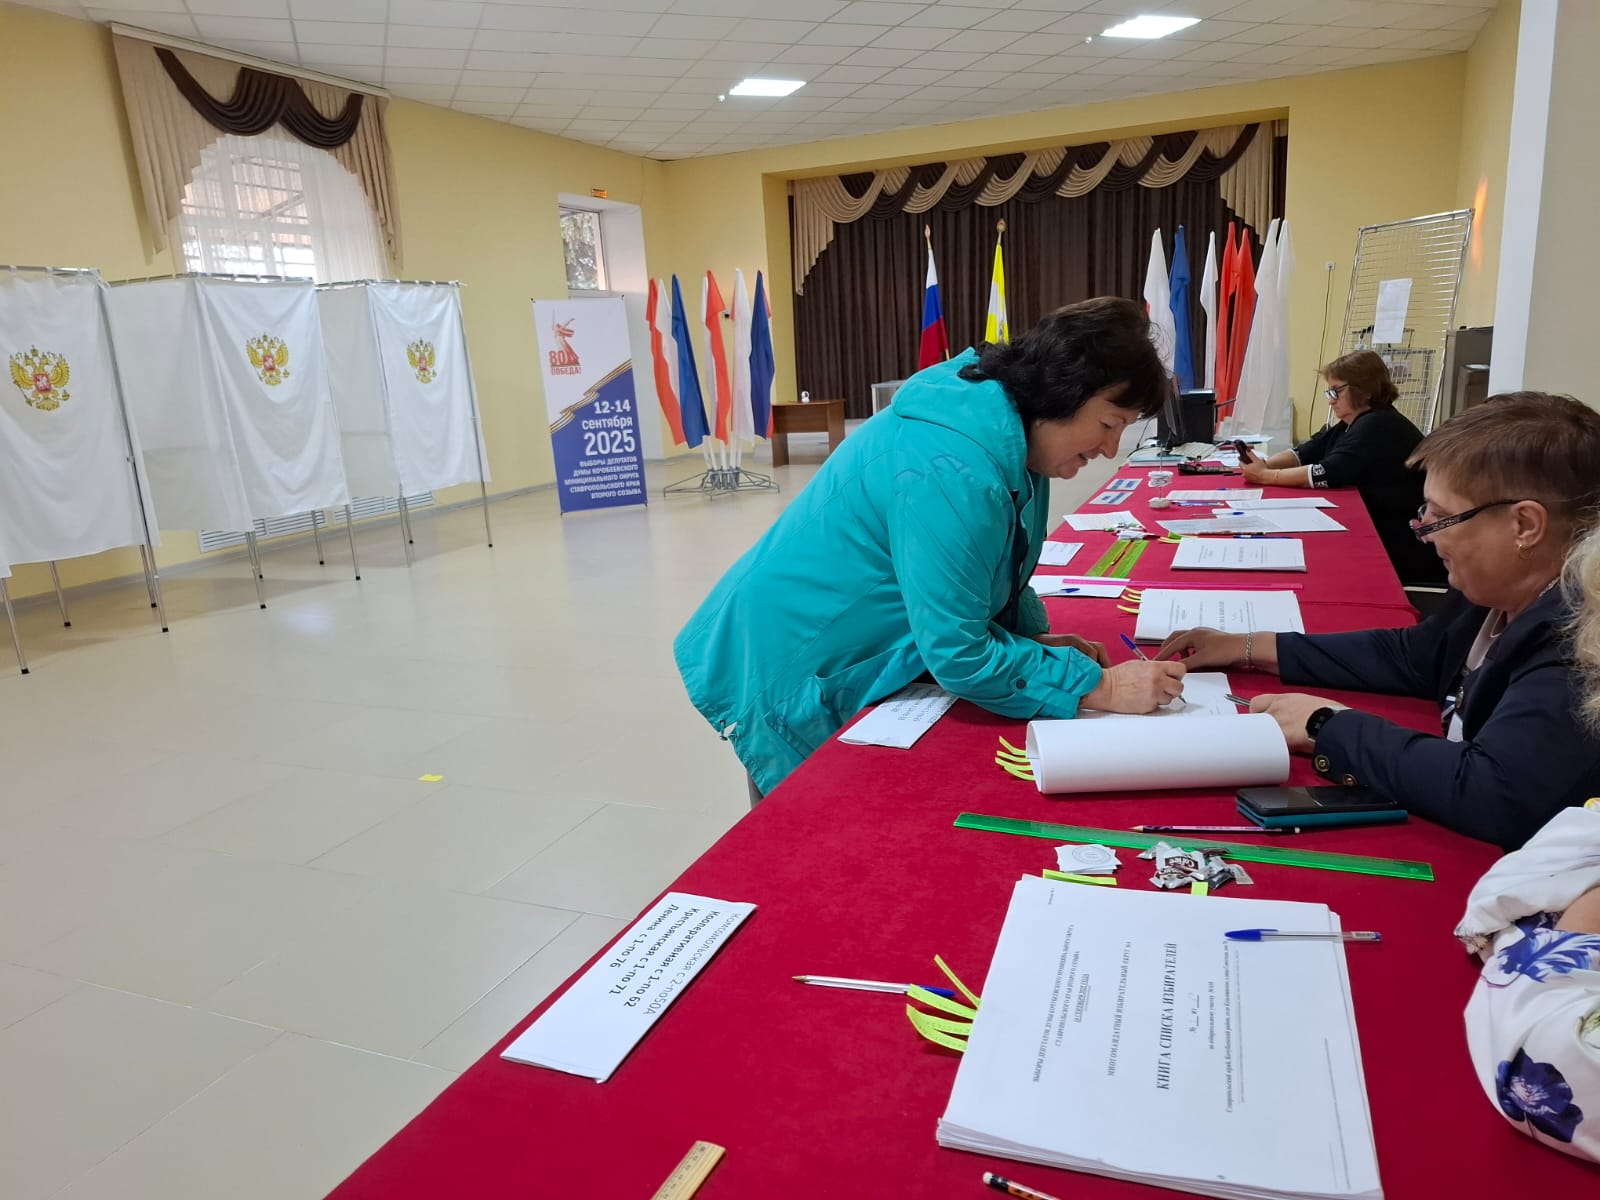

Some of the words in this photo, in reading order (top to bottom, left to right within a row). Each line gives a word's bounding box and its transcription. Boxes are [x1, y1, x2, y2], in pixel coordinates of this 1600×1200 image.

[551, 366, 581, 376] ПОБЕДА!
[594, 400, 631, 414] 12-14
[582, 416, 633, 430] сентября
[584, 429, 635, 456] 2025
[607, 456, 637, 464] ДЕПУТАТОВ
[564, 474, 618, 485] МУНИЦИПАЛЬНОГО
[573, 469, 591, 477] ДУМЫ
[570, 482, 624, 493] СТАВРОПОЛЬСКОГО
[592, 491, 616, 499] ВТОРОГО
[647, 904, 679, 930] Ленина
[646, 908, 700, 956] Крестьянская
[660, 911, 720, 968] Кооперативная
[621, 939, 644, 956] 1-по
[682, 913, 741, 971] Комсомольская
[610, 959, 626, 968] 76
[621, 964, 644, 982] 1-по
[1162, 943, 1177, 1004] ИЗБИРАТЕЛЕЙ
[609, 985, 627, 994] 71
[636, 976, 659, 994] 1-по
[624, 996, 640, 1007] 62
[1160, 1008, 1174, 1049] СПИСКА
[1107, 1014, 1123, 1076] МНОГОМАНДАТНЫЙ
[1156, 1052, 1171, 1090] КНИГА
